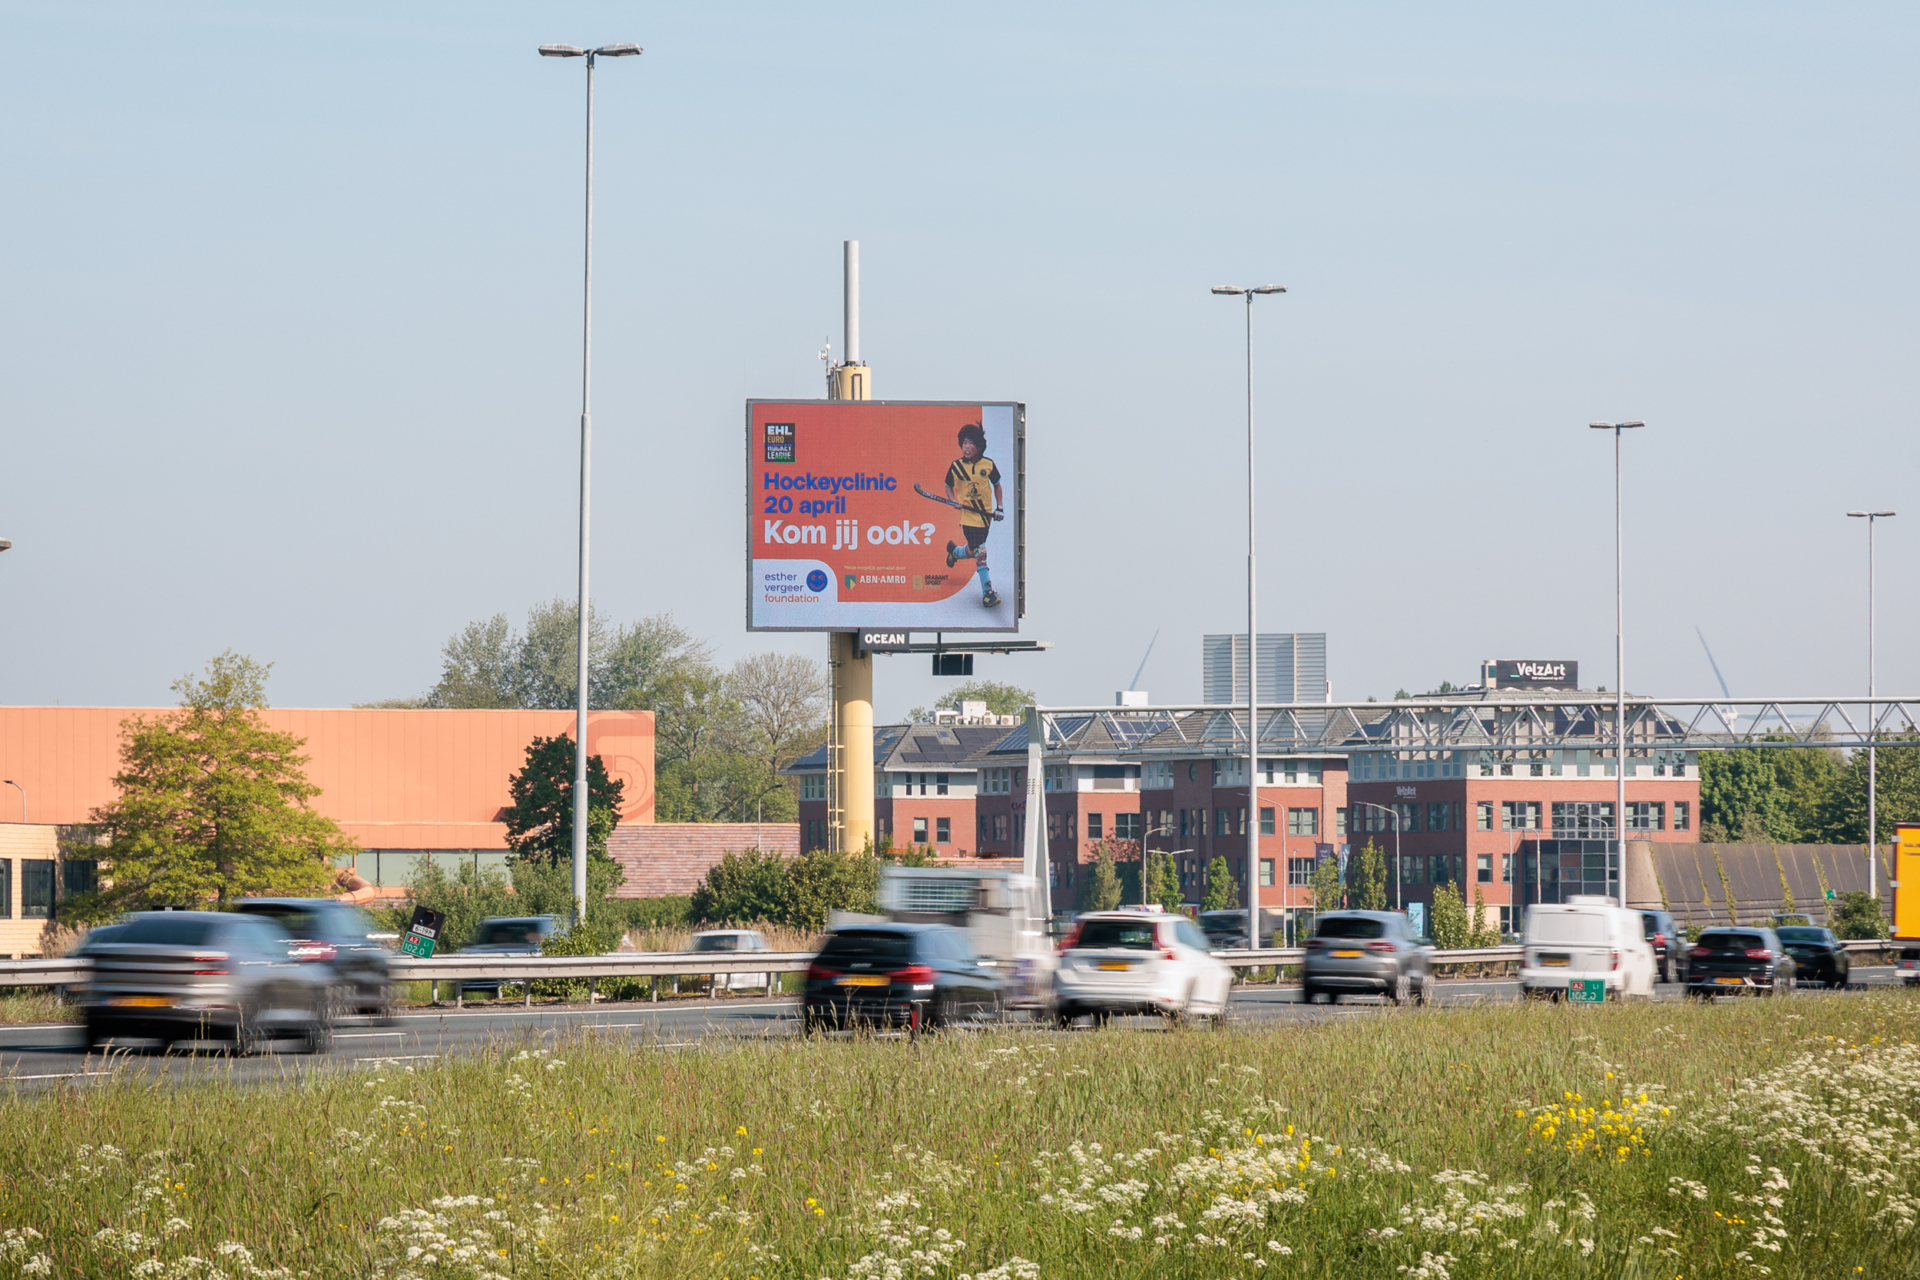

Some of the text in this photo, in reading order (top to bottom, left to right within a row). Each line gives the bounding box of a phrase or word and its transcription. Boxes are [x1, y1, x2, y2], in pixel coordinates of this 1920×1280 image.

[767, 425, 793, 435] EHL
[767, 443, 792, 452] HOCKEY
[767, 451, 792, 460] LEAGUE
[764, 472, 897, 494] Hockeyclinic
[764, 496, 846, 518] 20 april
[764, 519, 936, 551] Kom jij ook?
[764, 572, 797, 581] esther
[764, 584, 804, 594] vergeer
[764, 593, 819, 603] foundation
[864, 633, 905, 644] OCEAN
[1516, 662, 1566, 676] VelzArt
[404, 943, 425, 956] 102.0
[1572, 992, 1596, 1000] 102.0
